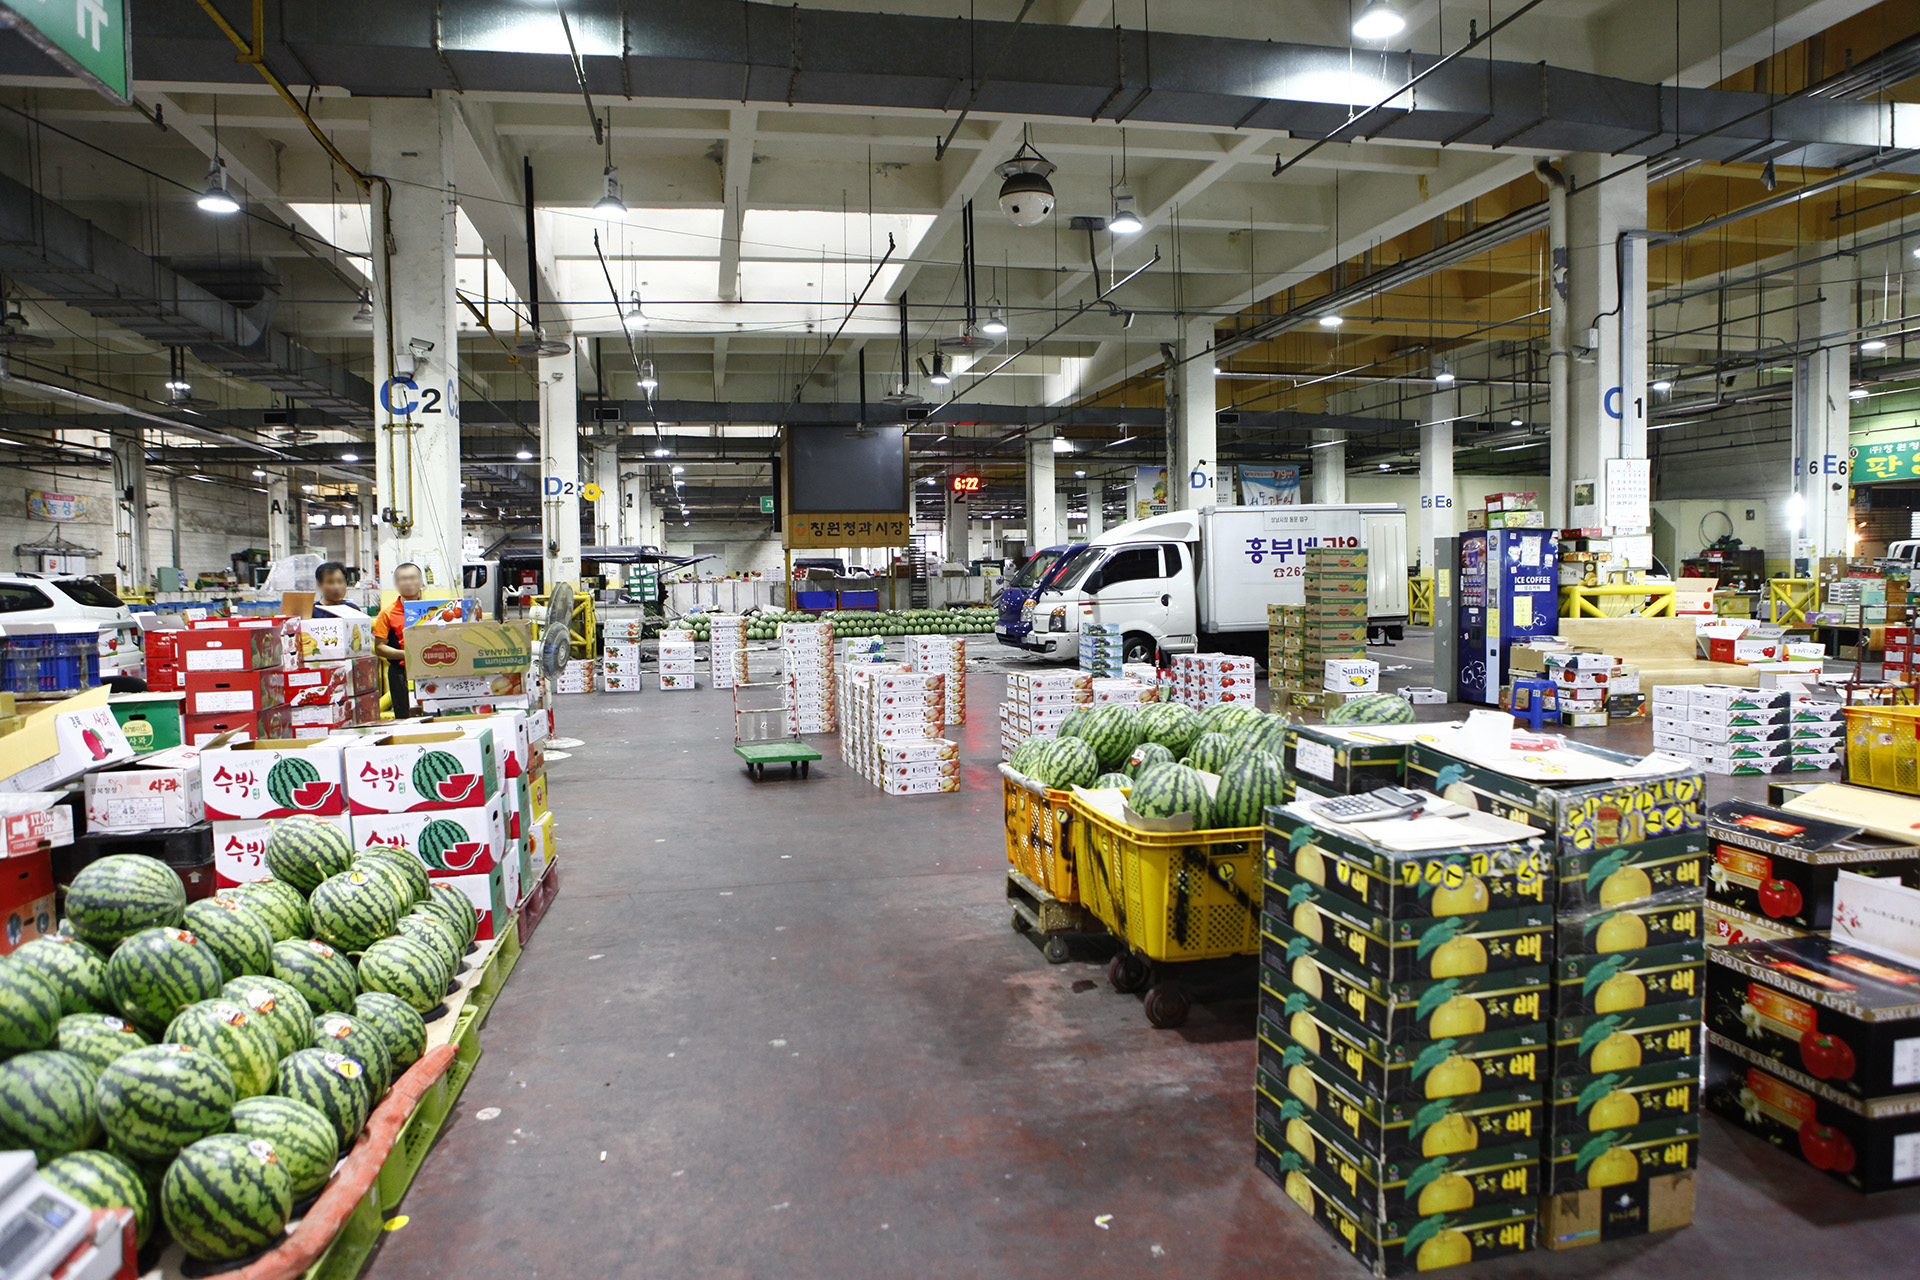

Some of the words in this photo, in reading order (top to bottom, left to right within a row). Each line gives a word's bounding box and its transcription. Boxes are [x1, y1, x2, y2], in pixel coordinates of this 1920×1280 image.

[380, 377, 441, 415] C2
[1824, 455, 1847, 475] E6
[545, 477, 574, 495] D2
[954, 478, 979, 490] 6:22
[1192, 472, 1214, 488] D1
[1435, 495, 1452, 508] E8
[810, 521, 904, 536] 창원청과시장
[478, 648, 523, 656] BANANAS
[1342, 665, 1375, 676] Sunkist
[149, 778, 178, 792] 사과
[213, 765, 259, 798] 수박
[360, 761, 404, 792] 수박
[1680, 782, 1691, 799] 7
[35, 824, 54, 835] FRUIT
[224, 835, 264, 866] 수박
[1718, 831, 1772, 853] SANBARAM
[1775, 845, 1809, 863] APPLE
[1817, 853, 1846, 865] SOBAK
[1847, 851, 1892, 863] SANBARAM
[1893, 848, 1920, 860] APPLE
[1341, 862, 1347, 876] 7
[1405, 866, 1416, 882] 7
[1429, 864, 1441, 878] 7
[1473, 856, 1484, 873] 7
[1677, 860, 1700, 886] 배
[1351, 870, 1368, 903] 배
[1672, 911, 1696, 938] 배
[1704, 900, 1751, 921] REMIUM
[1756, 917, 1794, 936] APPLE
[1349, 931, 1366, 965] 배
[1515, 934, 1542, 962] 배
[1670, 969, 1694, 995] 배
[1710, 951, 1747, 976] SOBAK
[1750, 967, 1817, 1001] SANBARAM
[1820, 995, 1863, 1019] APPLE
[1348, 990, 1365, 1022] 배
[1512, 993, 1539, 1021] 배
[1874, 1009, 1906, 1022] SOBAK
[1667, 1029, 1690, 1055] 배
[342, 1063, 351, 1075] 7
[1346, 1049, 1363, 1081] 배
[1510, 1053, 1536, 1081] 배
[1710, 1034, 1747, 1061] SOBAK
[1749, 1052, 1817, 1092] SANBARAM
[1820, 1085, 1861, 1114] APPLE
[1664, 1087, 1690, 1112] 배
[1874, 1105, 1906, 1117] SOBAK
[1343, 1105, 1359, 1139] 배
[1506, 1109, 1532, 1137] 배
[1664, 1143, 1688, 1168] 배
[1340, 1163, 1357, 1196] 배
[1501, 1168, 1526, 1195] 배
[1339, 1219, 1356, 1252] 배
[1498, 1224, 1524, 1250] 배
